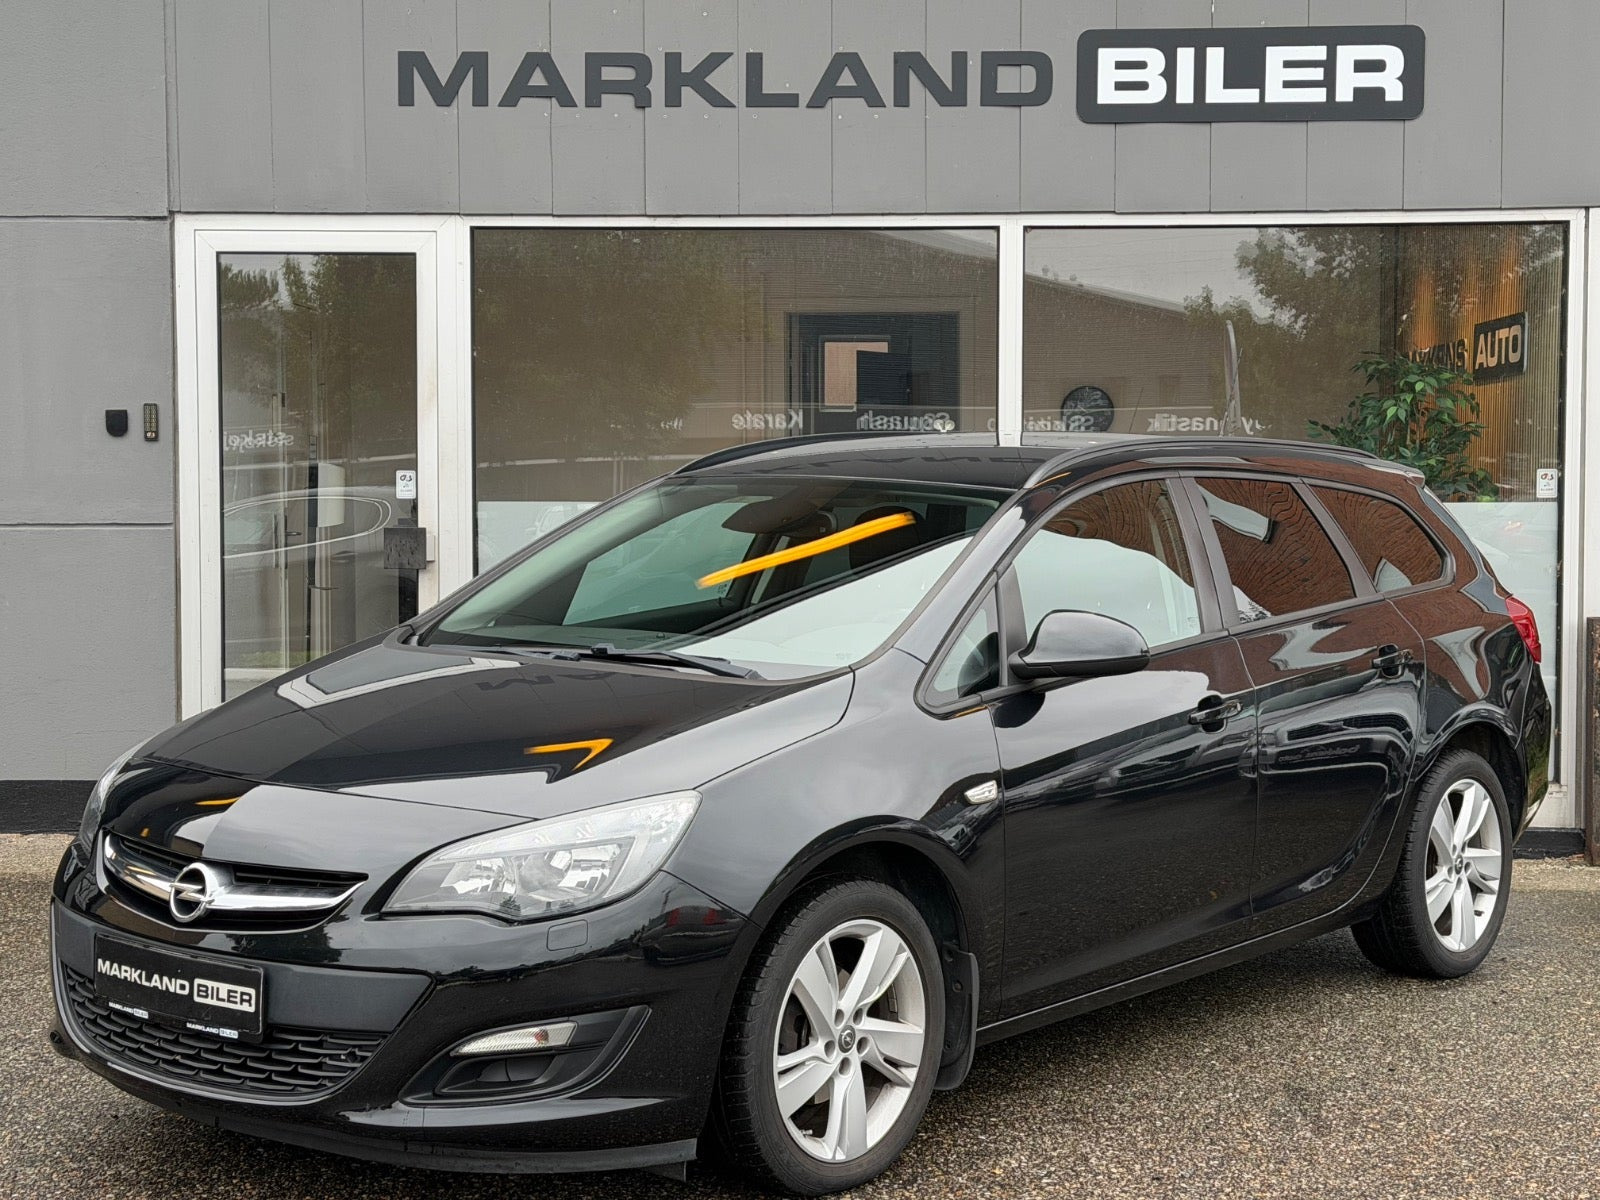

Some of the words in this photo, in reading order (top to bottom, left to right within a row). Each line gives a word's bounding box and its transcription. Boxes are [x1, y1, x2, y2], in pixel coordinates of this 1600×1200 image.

[398, 50, 1052, 108] MARKLAND
[1096, 43, 1405, 106] BILER
[1475, 324, 1522, 370] AUTO
[97, 958, 190, 996] MARKLAND
[196, 980, 253, 1009] BILER
[108, 1001, 134, 1014] MARKLAND
[186, 1021, 219, 1035] MARKLAND
